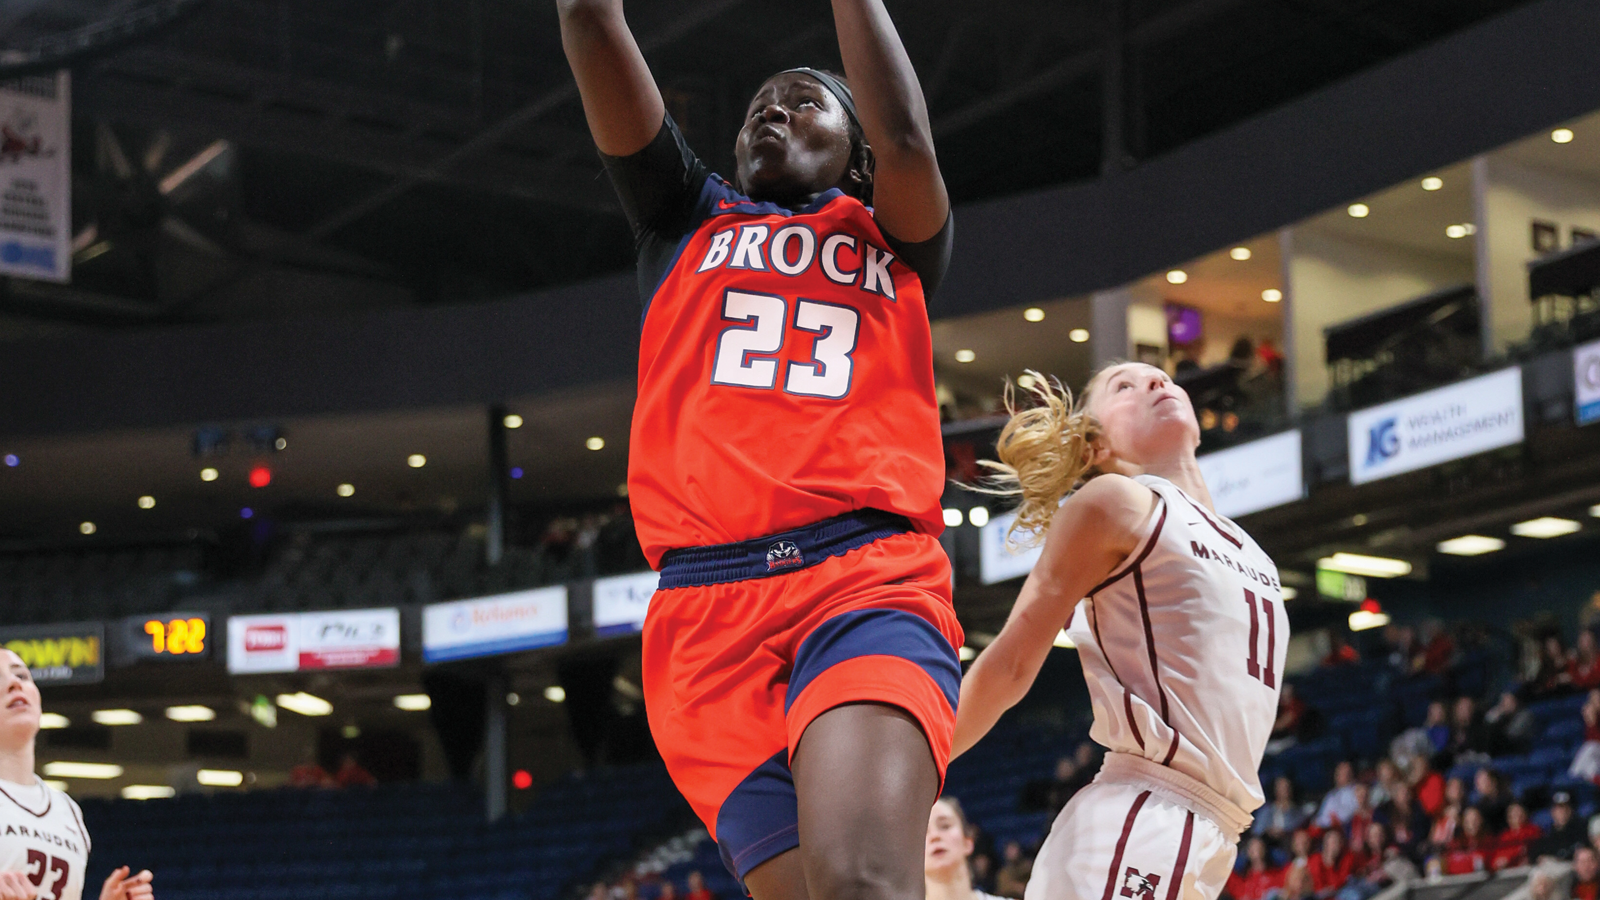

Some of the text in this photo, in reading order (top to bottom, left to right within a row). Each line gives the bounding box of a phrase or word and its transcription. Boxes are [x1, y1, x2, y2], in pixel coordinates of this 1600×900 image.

[696, 223, 897, 302] BROCK
[710, 288, 860, 400] 23
[1243, 587, 1276, 691] 11
